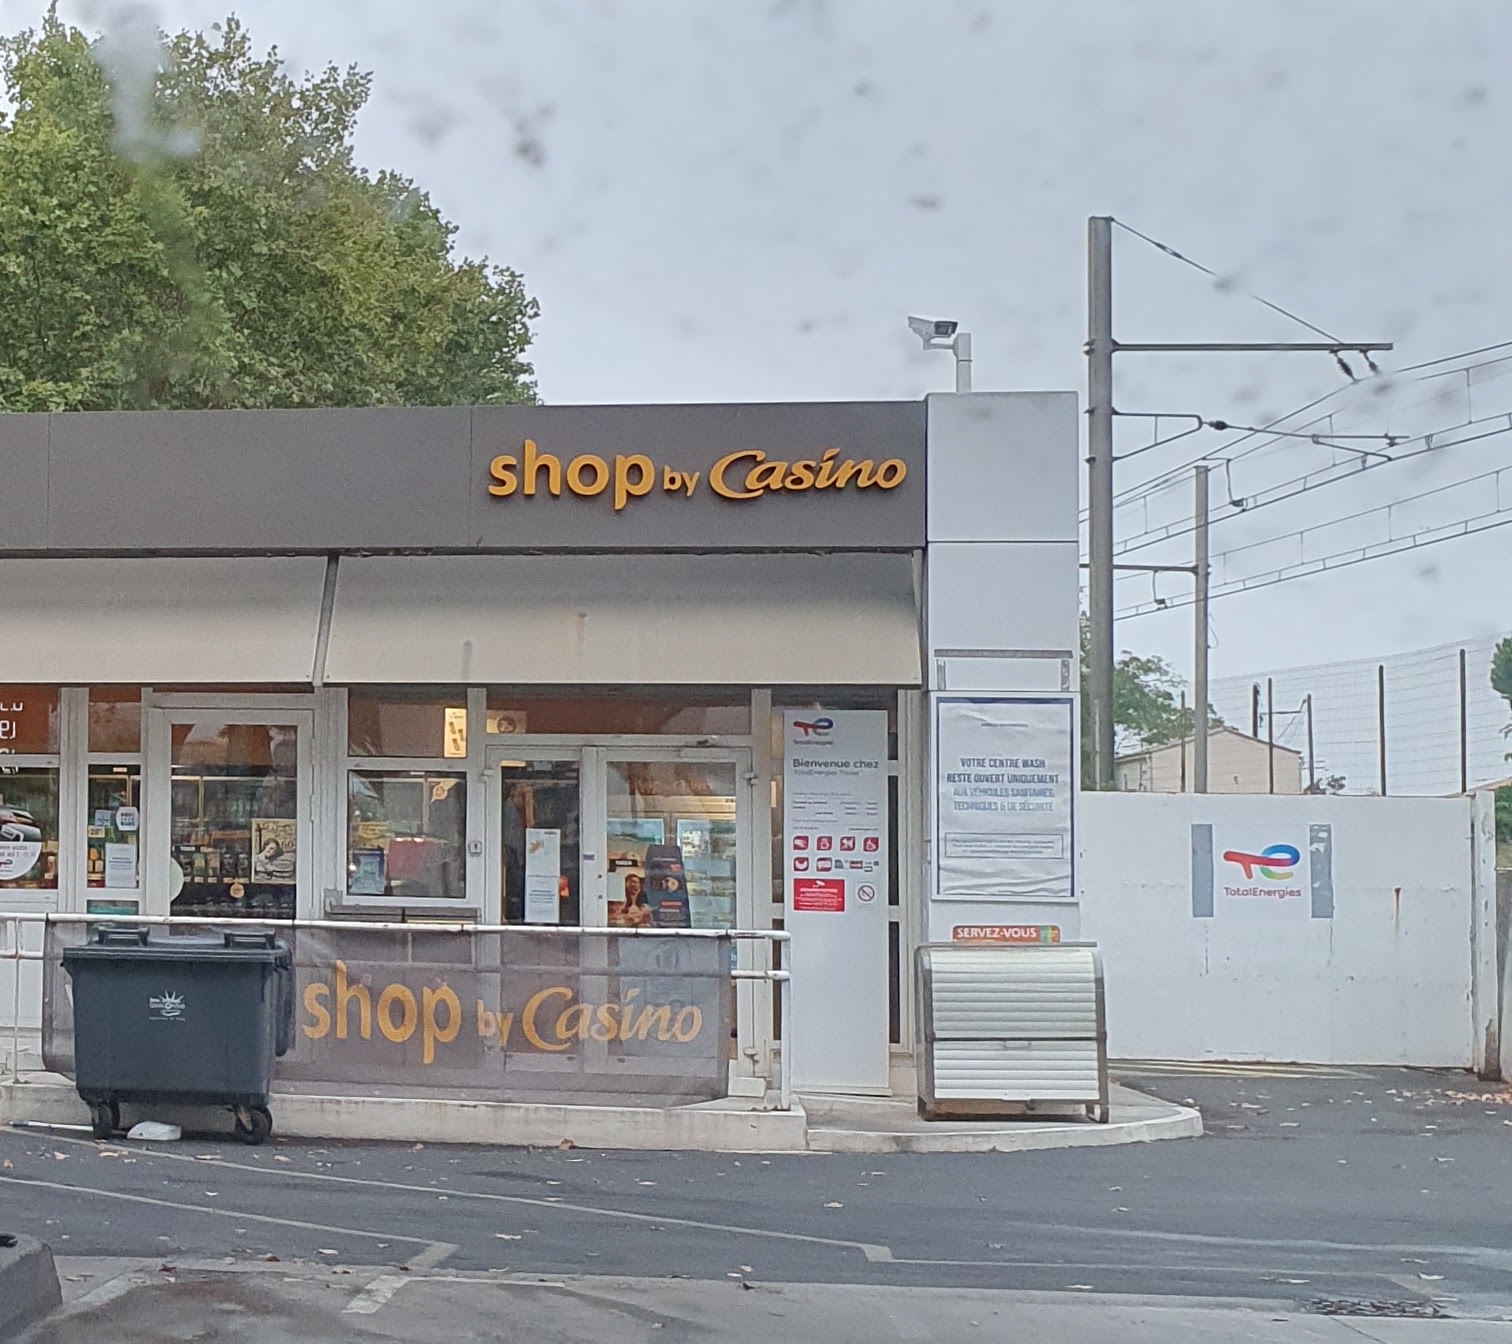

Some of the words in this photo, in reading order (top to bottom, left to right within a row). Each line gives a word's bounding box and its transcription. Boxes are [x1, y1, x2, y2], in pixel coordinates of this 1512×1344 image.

[489, 439, 655, 510] shop
[663, 465, 700, 496] by
[709, 448, 907, 499] Casino
[792, 759, 850, 768] Bienvenue
[853, 759, 879, 768] chez
[960, 758, 986, 768] VOTRE
[988, 758, 1020, 768] CENTRE
[1022, 759, 1046, 769] WASH
[947, 773, 972, 783] RESTE
[974, 773, 1005, 783] OUVERT
[1223, 886, 1301, 899] TotalEnergies
[956, 927, 1037, 938] SERVEZ-VOUS
[302, 960, 462, 1064] shop
[477, 999, 514, 1047] by
[522, 987, 703, 1051] Casino
